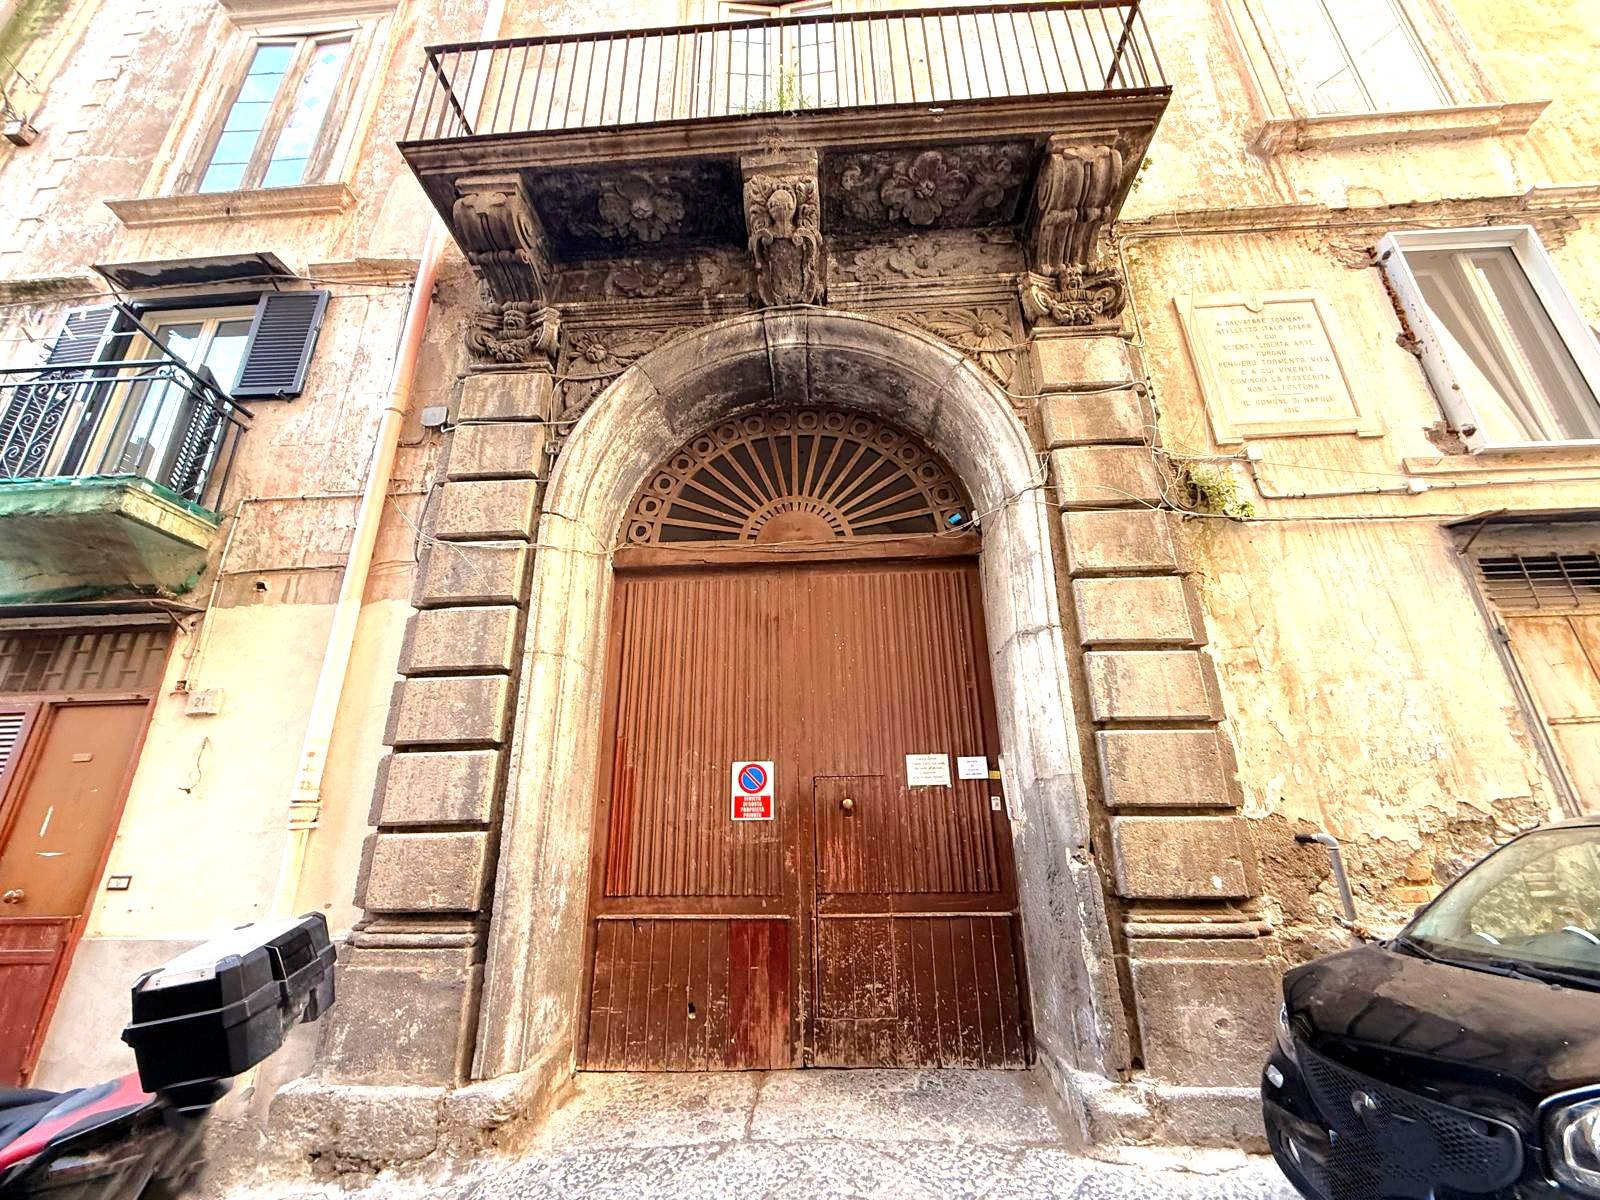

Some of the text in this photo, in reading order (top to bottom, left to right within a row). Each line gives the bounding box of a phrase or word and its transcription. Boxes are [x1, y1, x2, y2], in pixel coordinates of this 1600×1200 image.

[1225, 317, 1265, 327] SALVATORE
[1261, 324, 1284, 332] ITALO
[1218, 360, 1257, 368] PENSIERO
[1255, 398, 1289, 406] COMUNE
[1304, 395, 1336, 404] NAPOLI
[194, 697, 205, 707] 21
